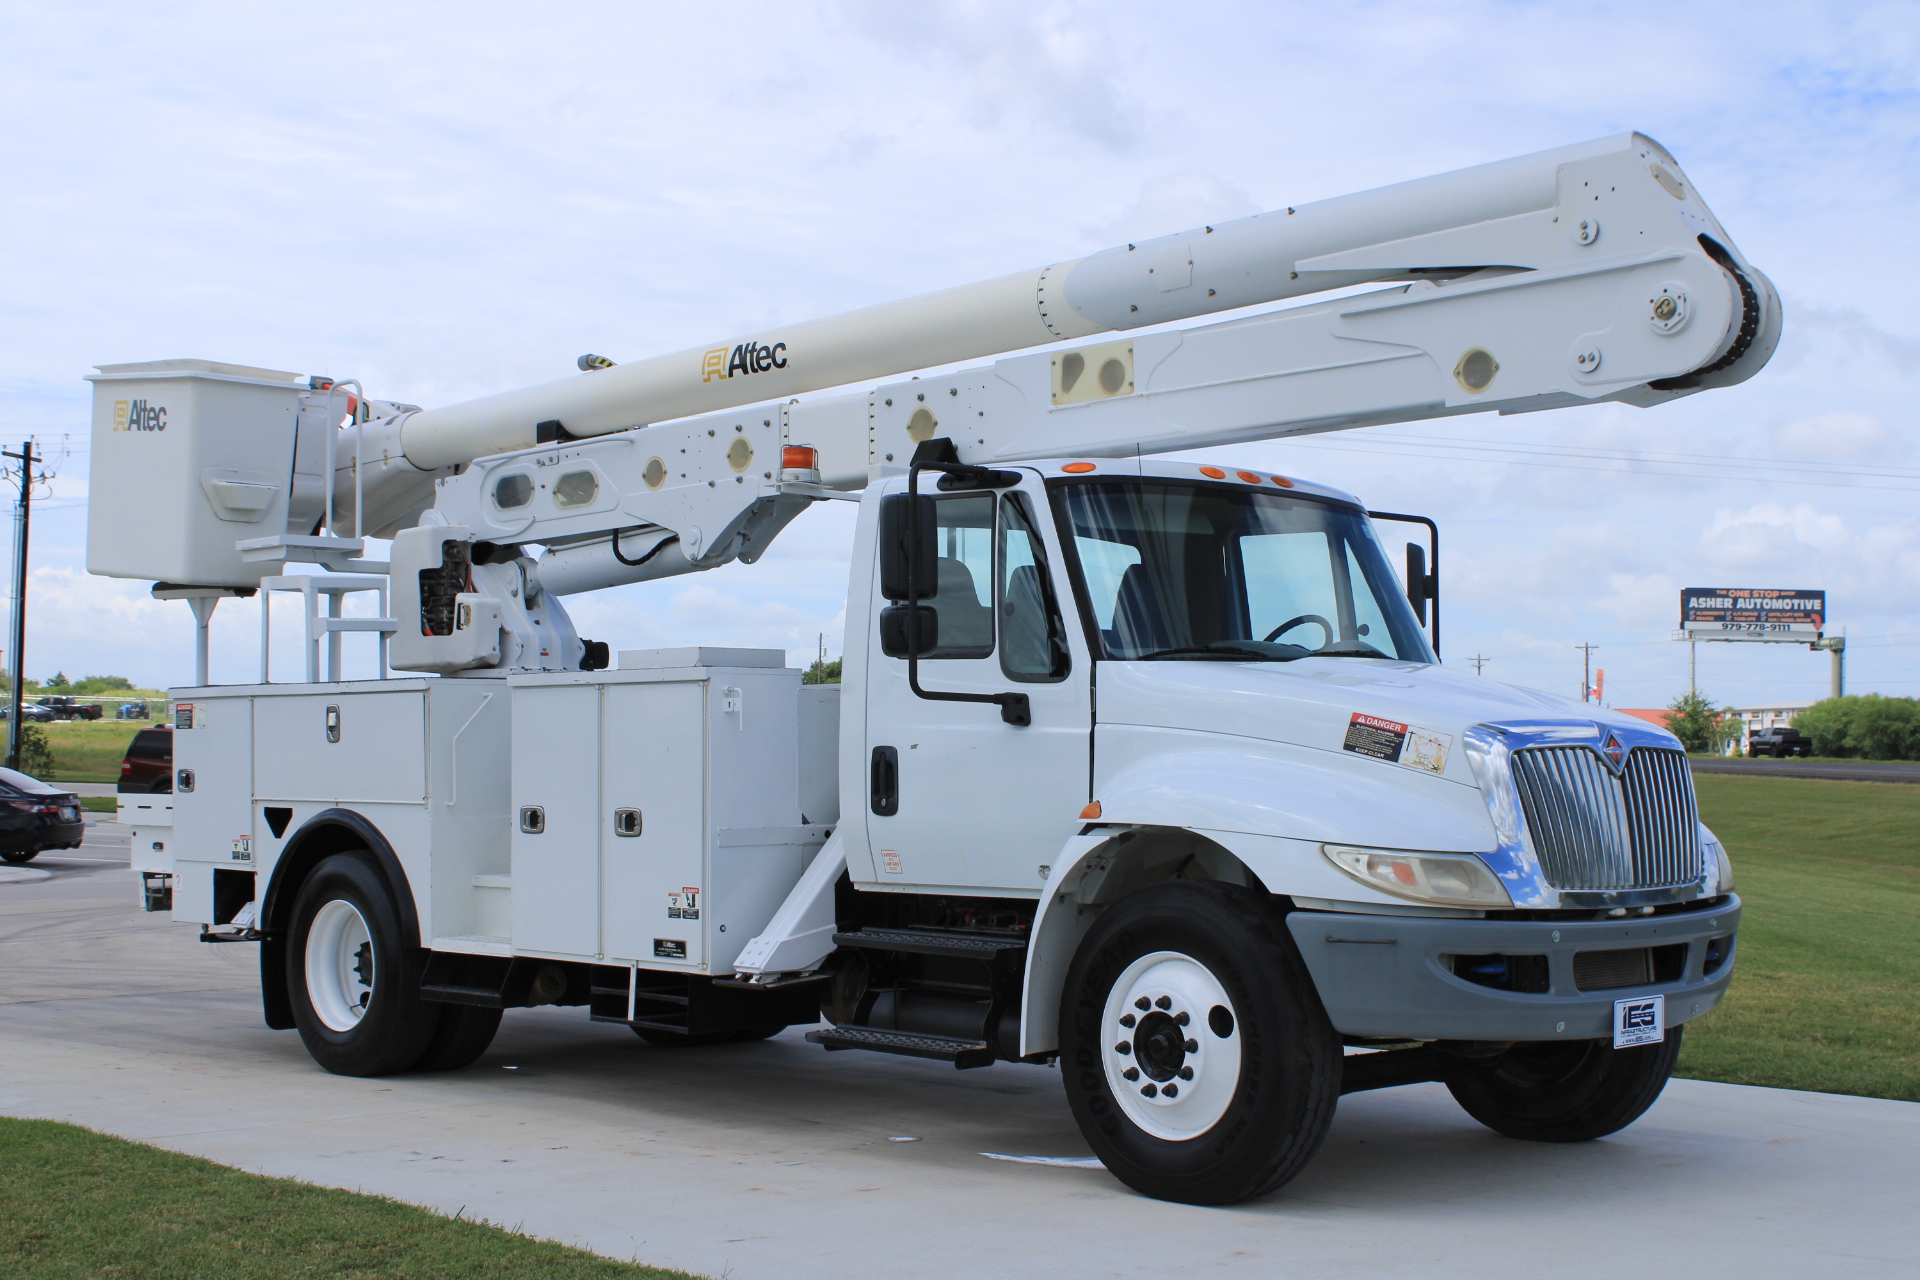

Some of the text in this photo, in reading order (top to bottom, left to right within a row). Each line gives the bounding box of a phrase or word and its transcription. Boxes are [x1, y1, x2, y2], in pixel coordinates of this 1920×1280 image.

[727, 341, 787, 378] Altec
[127, 399, 167, 432] Altec
[1728, 590, 1750, 598] ONE
[1752, 590, 1780, 598] STOP
[1689, 597, 1822, 610] ASHER AUTOMOTIVE
[1721, 623, 1791, 632] 979-778-9111
[1366, 717, 1402, 732] DANGER
[1354, 747, 1385, 758] KEEP CLEAR
[1075, 929, 1138, 1138] GOODYEAR
[1620, 1026, 1657, 1035] INFRASTRUCTURE
[1214, 952, 1262, 1157] WORKHORSE MSA
